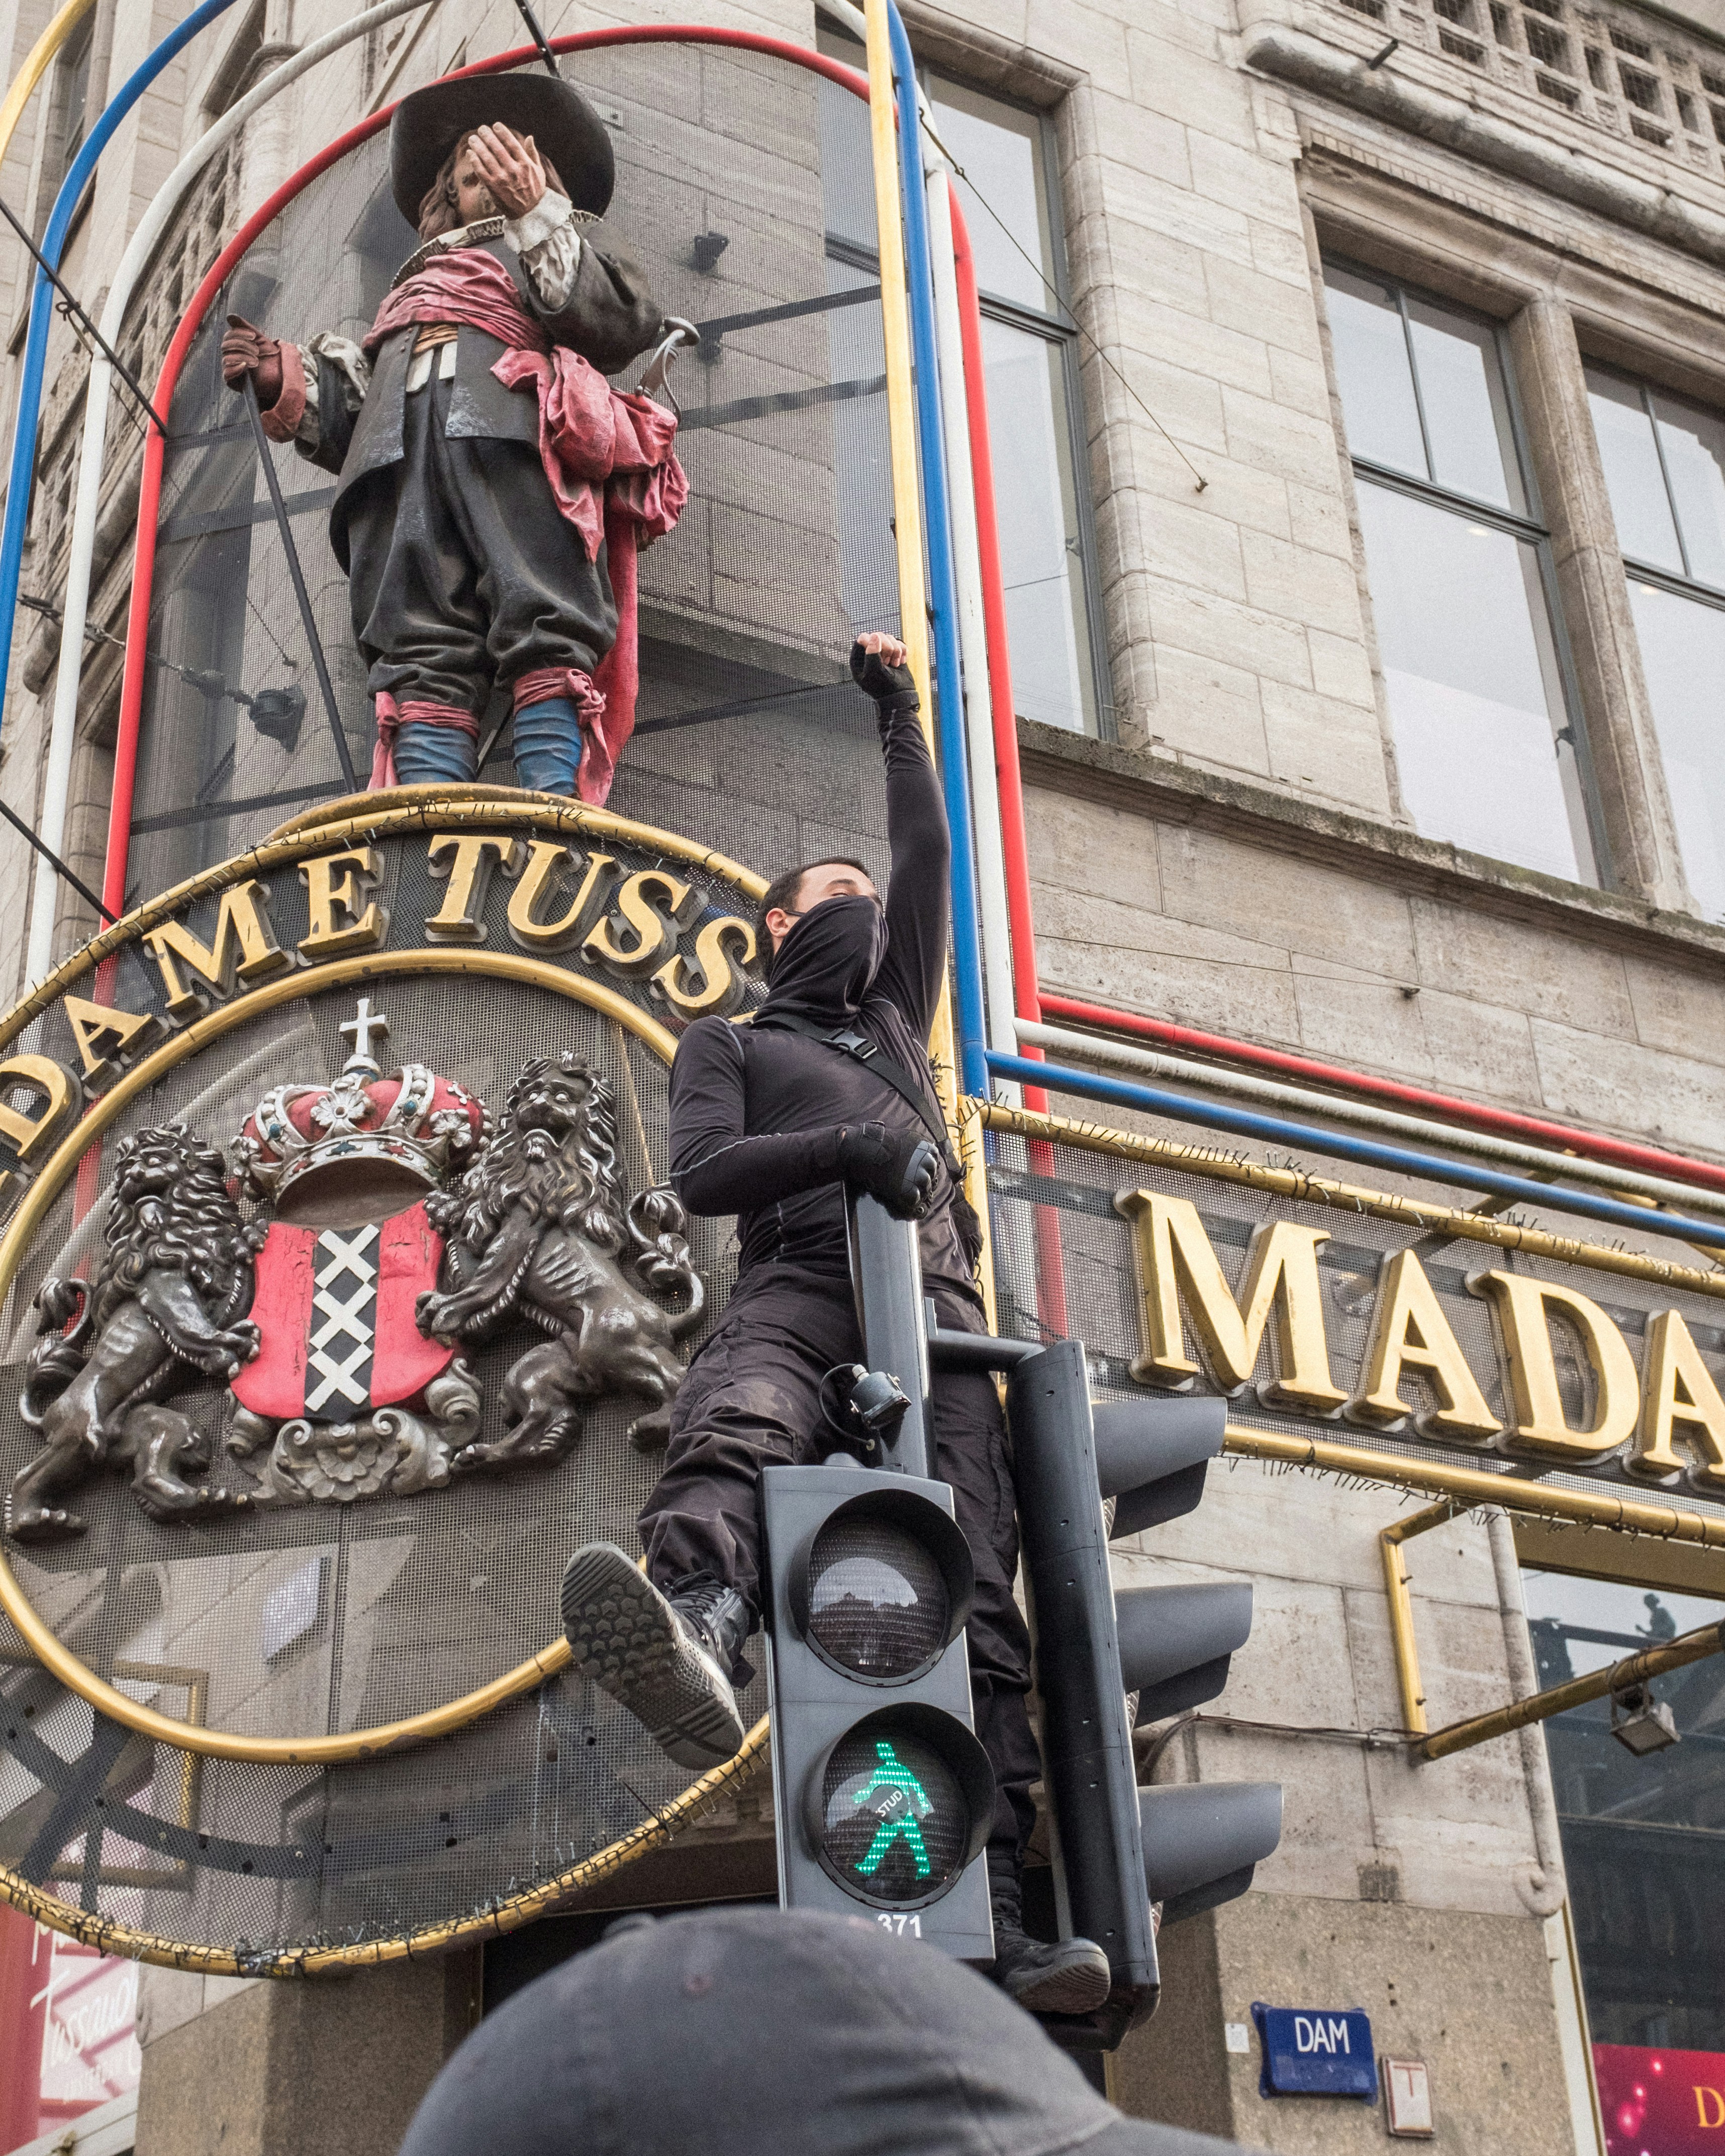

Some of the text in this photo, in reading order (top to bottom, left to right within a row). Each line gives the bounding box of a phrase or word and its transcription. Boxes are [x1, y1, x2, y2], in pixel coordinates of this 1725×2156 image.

[0, 834, 760, 1189] DAME TUSS
[1115, 1188, 1725, 1484] MADA
[877, 1913, 921, 1938] 371
[1294, 2016, 1351, 2054] DAM
[1692, 2086, 1725, 2128] D
